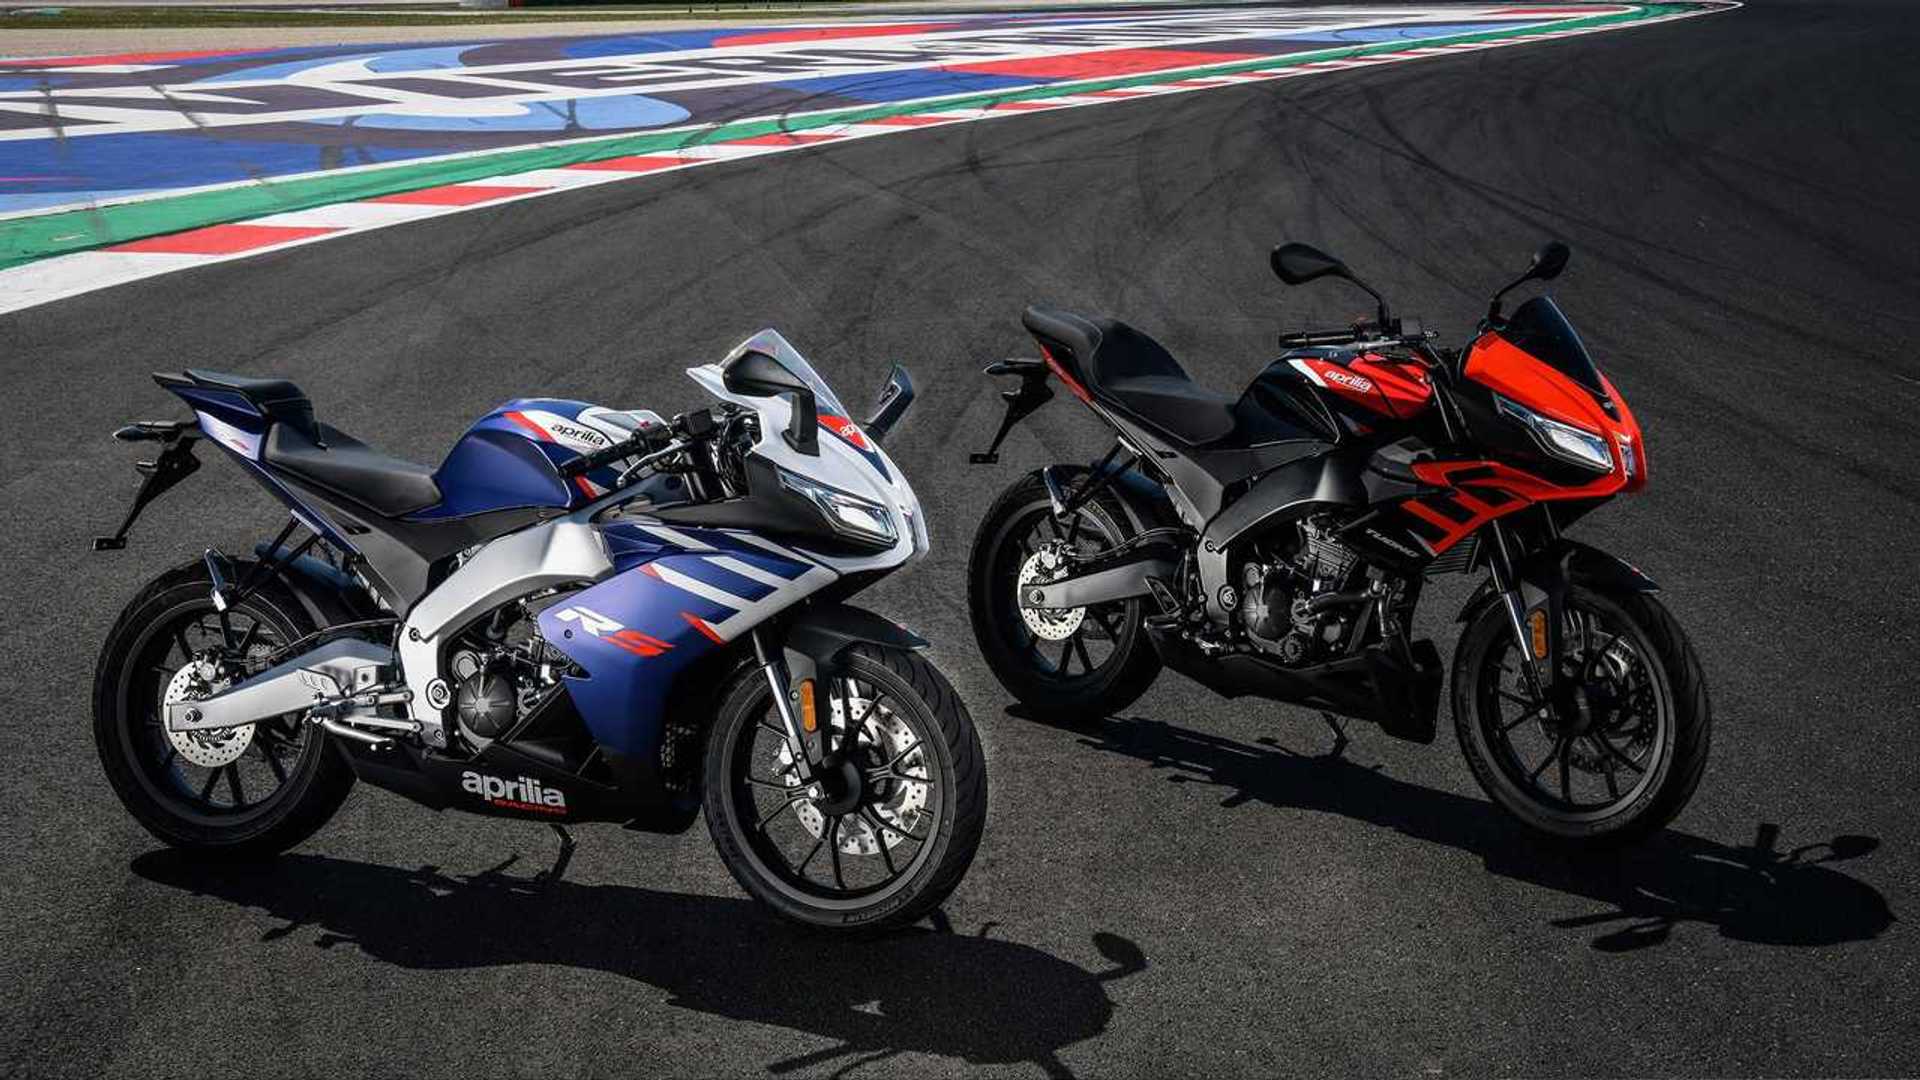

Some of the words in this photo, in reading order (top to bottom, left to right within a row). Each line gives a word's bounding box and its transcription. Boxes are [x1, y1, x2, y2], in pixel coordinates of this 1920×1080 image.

[1324, 370, 1371, 393] aprilia
[551, 423, 605, 445] aprilia
[554, 606, 674, 656] RS
[461, 770, 566, 807] aprilia
